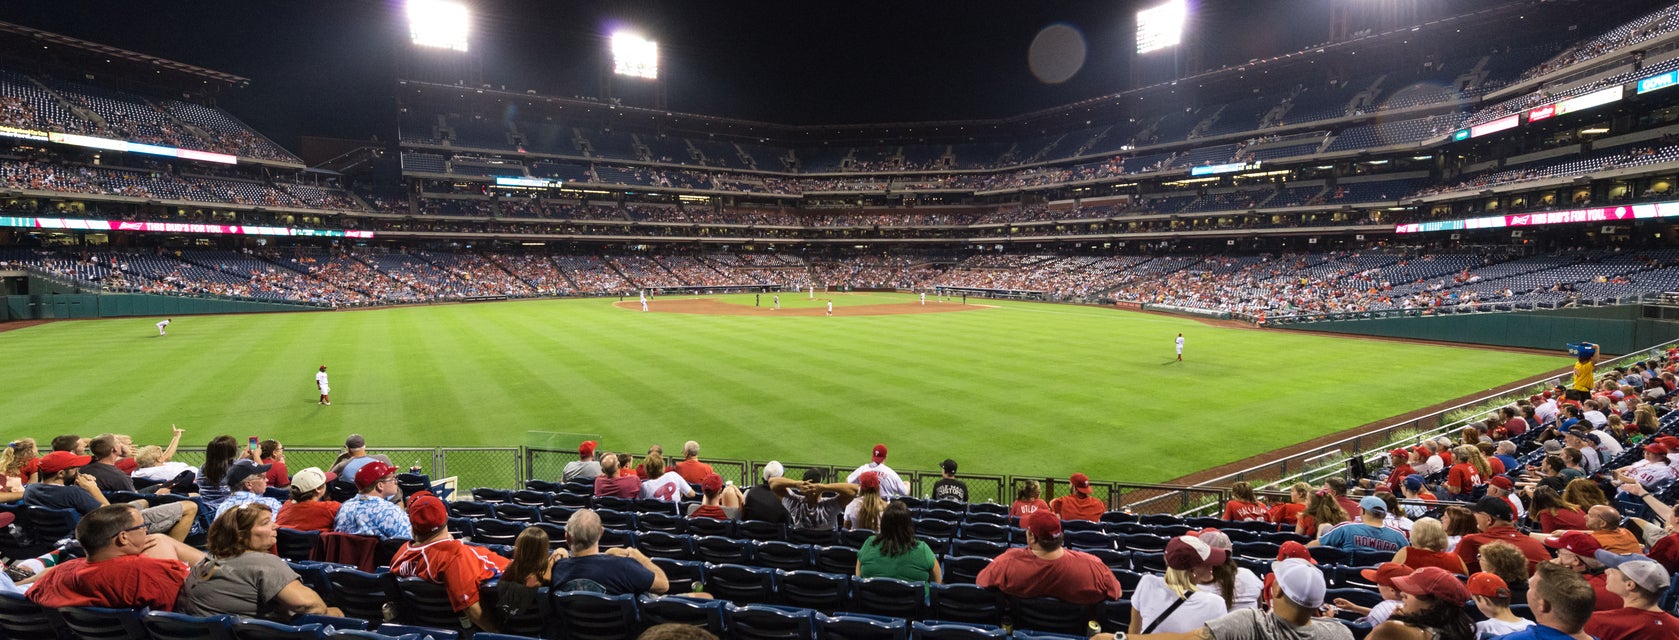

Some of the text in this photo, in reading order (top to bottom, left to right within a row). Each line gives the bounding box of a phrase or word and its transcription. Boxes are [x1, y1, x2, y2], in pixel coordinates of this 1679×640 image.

[1531, 212, 1548, 225] THIS
[1548, 211, 1570, 224] BUD'S
[1570, 209, 1587, 222] FOR
[1587, 208, 1607, 221] YOU.
[146, 222, 165, 231] THIS
[166, 223, 189, 232] BUD'S
[190, 224, 205, 233] FOR
[205, 224, 223, 233] YOU.
[1353, 534, 1399, 552] HOWARD
